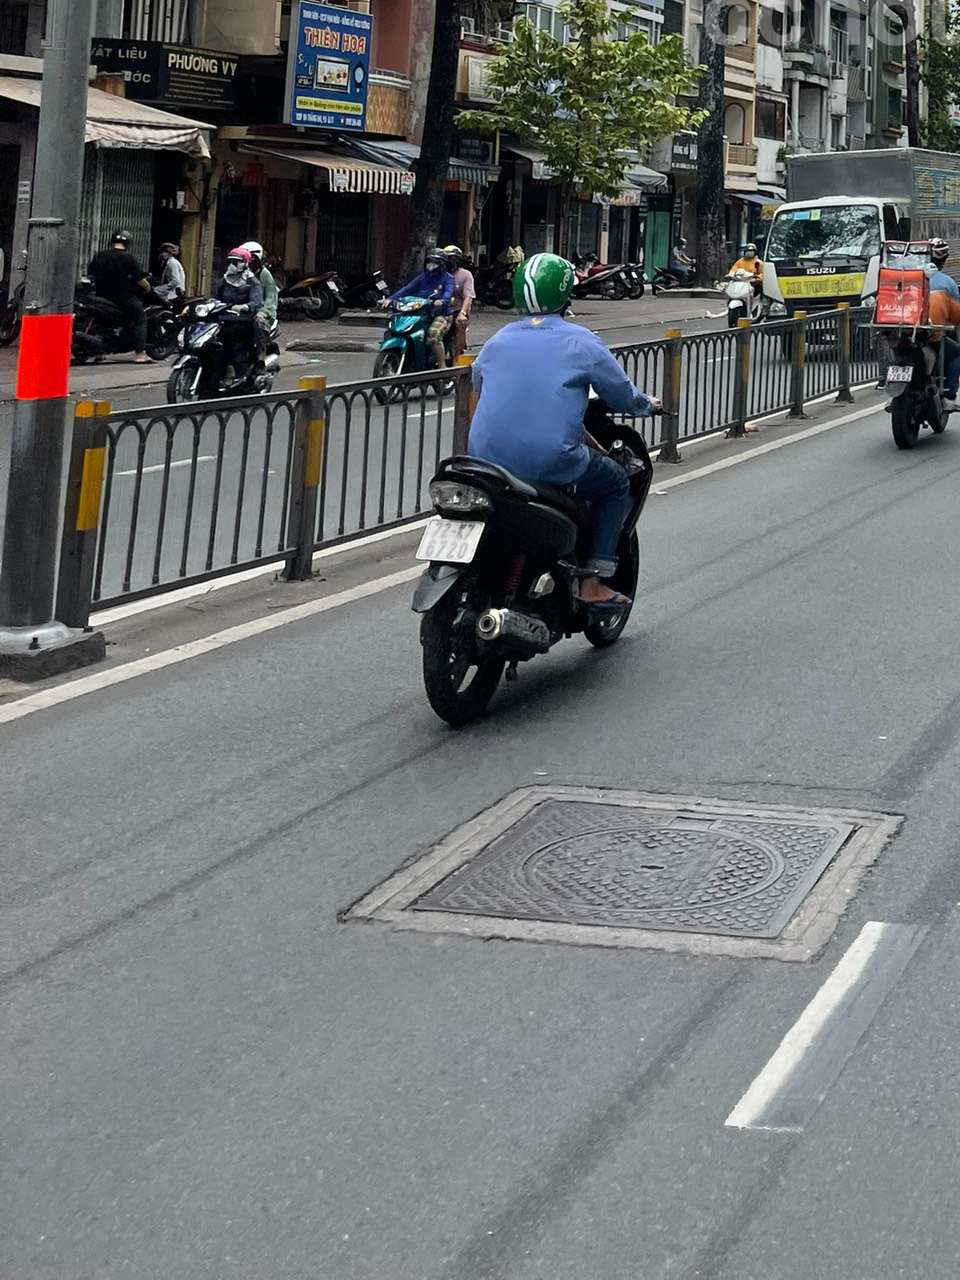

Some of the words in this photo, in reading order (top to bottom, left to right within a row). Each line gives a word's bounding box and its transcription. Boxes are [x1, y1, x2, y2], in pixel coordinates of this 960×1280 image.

[168, 52, 218, 74] PHƯƠNG
[222, 61, 238, 77] VY
[806, 266, 837, 275] ISUZU
